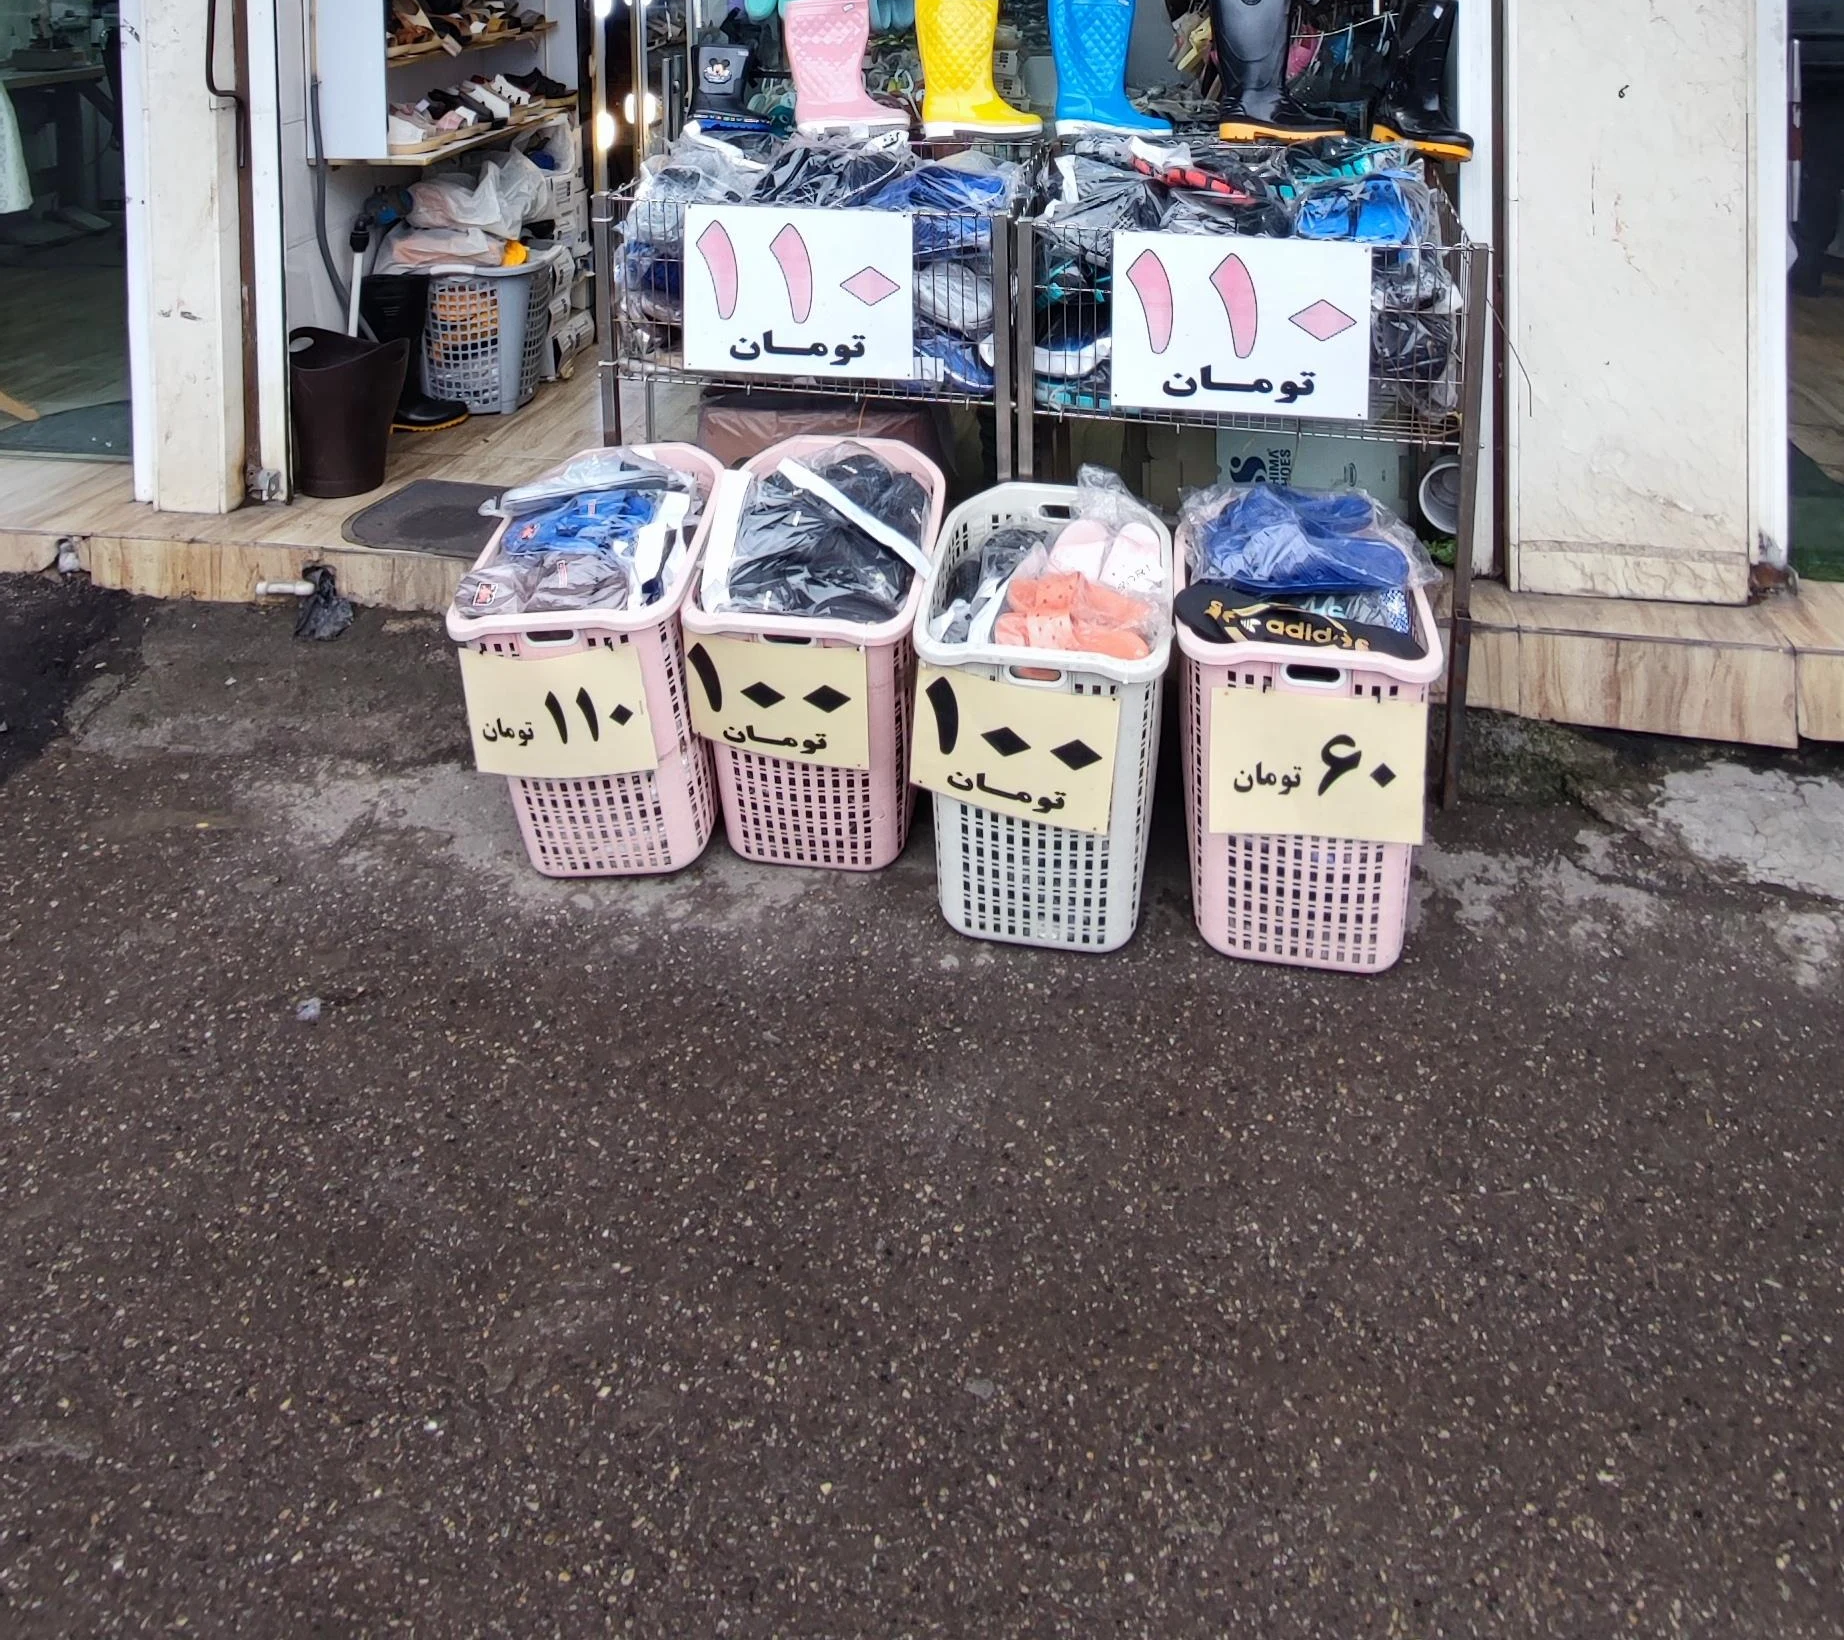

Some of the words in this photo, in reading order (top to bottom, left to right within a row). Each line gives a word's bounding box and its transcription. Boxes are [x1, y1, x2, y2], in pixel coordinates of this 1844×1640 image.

[695, 219, 901, 324] ۱۱۰
[1125, 248, 1358, 360] ۱۱۰
[729, 330, 866, 366] تومان
[1161, 366, 1317, 404] تومان
[1268, 448, 1280, 487] HIMA
[1280, 448, 1291, 487] HOES
[686, 641, 853, 714] ۱۰۰
[482, 718, 535, 747] تومان
[544, 686, 635, 745] ۱۱۰
[925, 676, 1104, 771] ۱۰۰
[722, 724, 828, 755] تومان
[1233, 761, 1302, 794] تومان
[1317, 733, 1398, 797] ۶۰
[946, 771, 1068, 814] تومان
